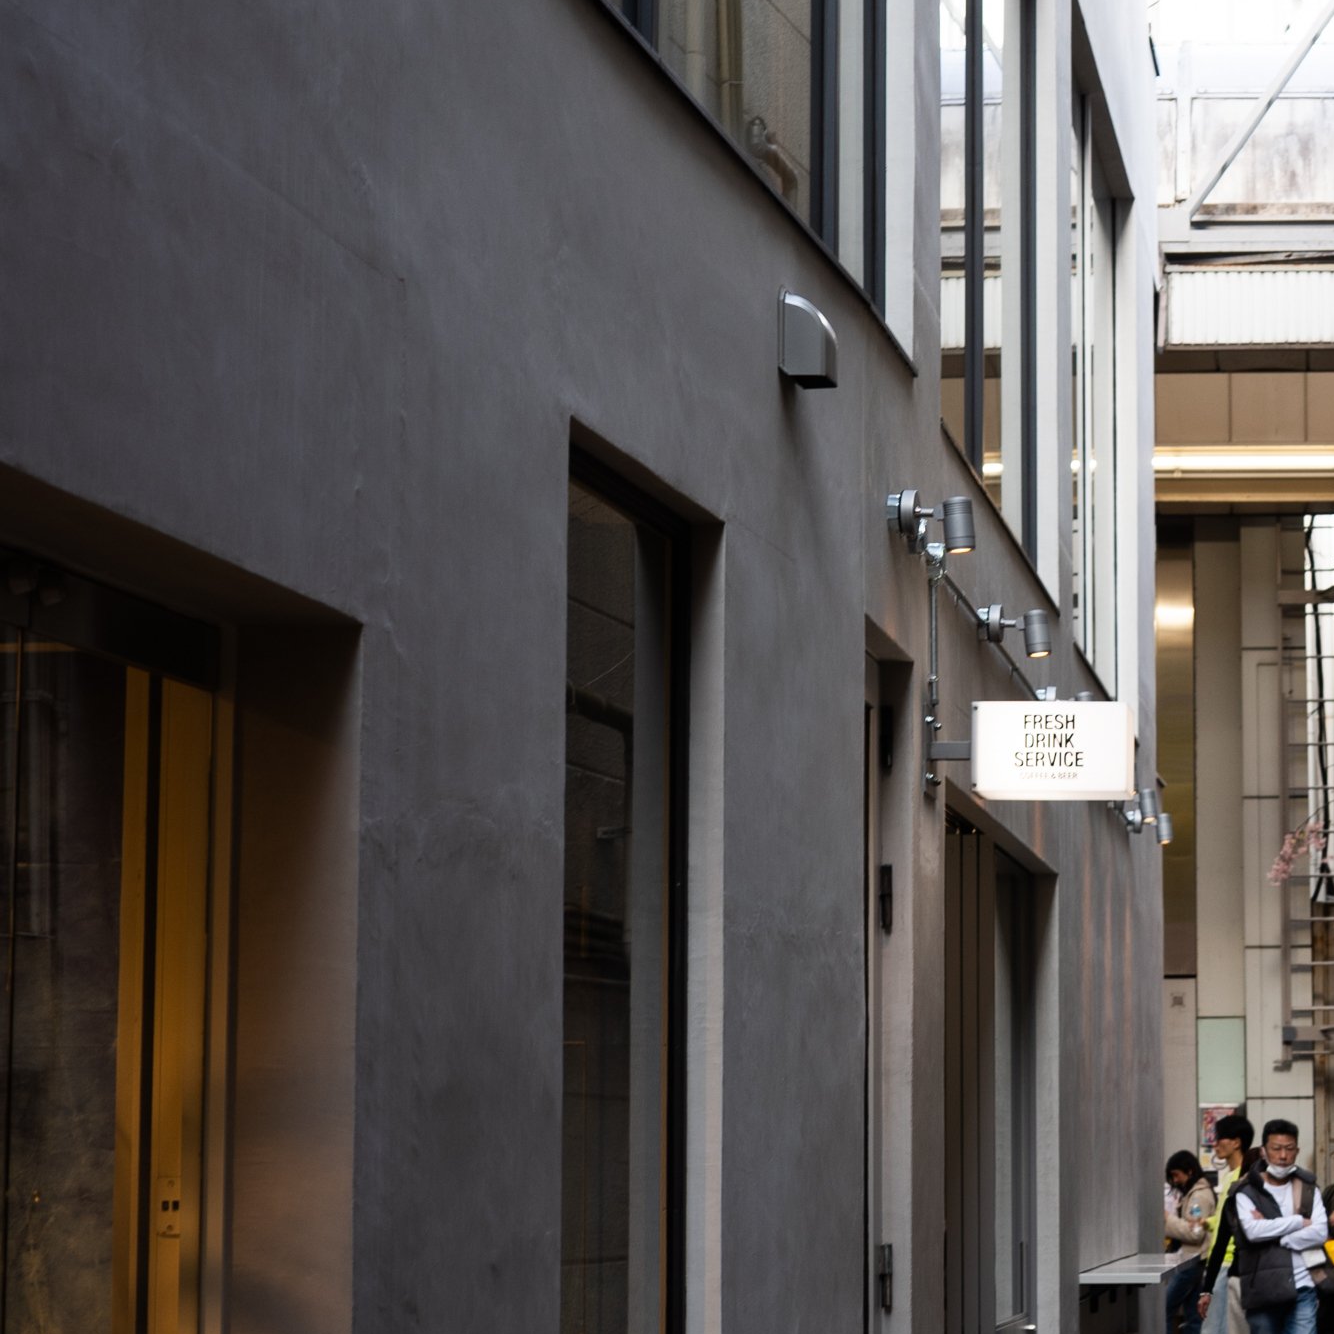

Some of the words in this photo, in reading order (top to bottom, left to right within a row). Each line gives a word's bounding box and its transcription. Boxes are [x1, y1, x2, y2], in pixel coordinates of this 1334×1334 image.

[1024, 714, 1075, 729] FRESH
[1025, 733, 1074, 748] DRINK
[1015, 752, 1084, 767] SERVICE
